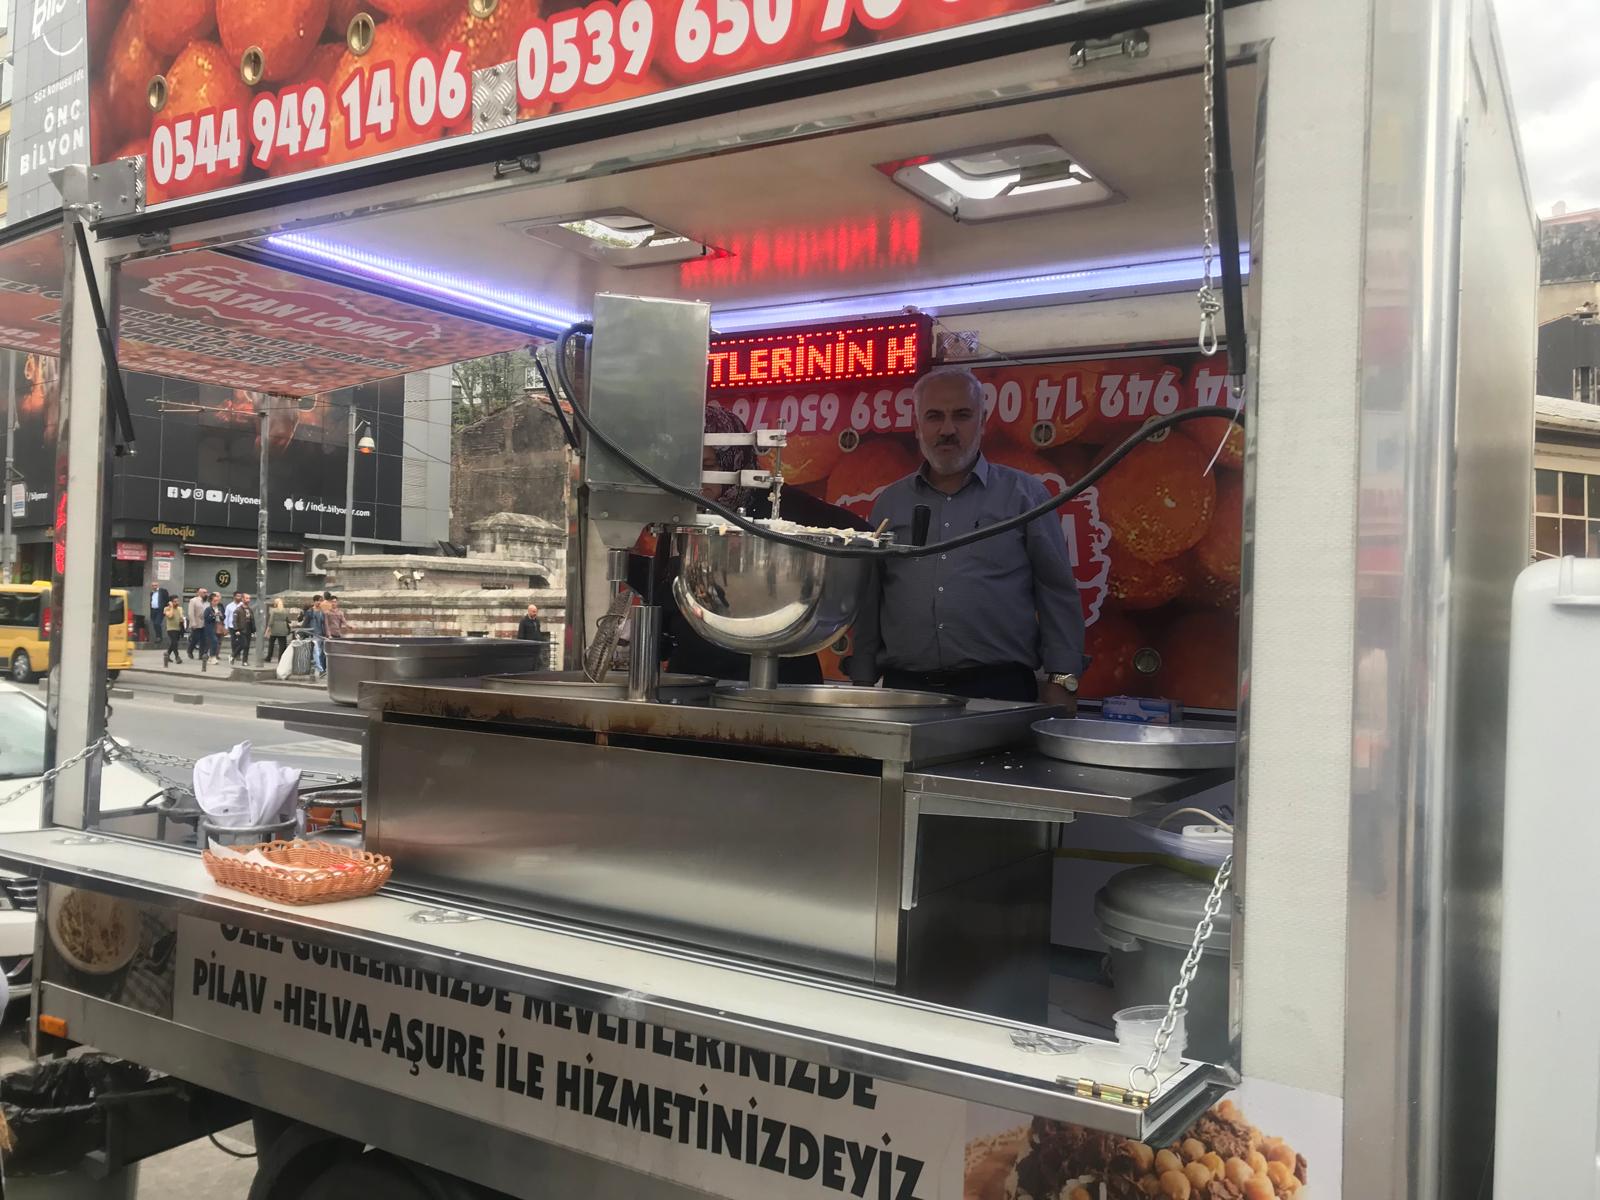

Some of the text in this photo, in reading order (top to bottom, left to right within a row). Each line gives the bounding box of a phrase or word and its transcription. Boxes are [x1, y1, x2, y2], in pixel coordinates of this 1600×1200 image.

[517, 0, 792, 100] 0539 650
[152, 49, 468, 185] 0544 942 14 06
[175, 281, 414, 341] VATAN LOKMA
[850, 388, 915, 431] 539
[1035, 377, 1084, 421] 14
[1100, 371, 1180, 417] 942
[192, 950, 268, 1015] PİLAV
[495, 1027, 545, 1100] İLE
